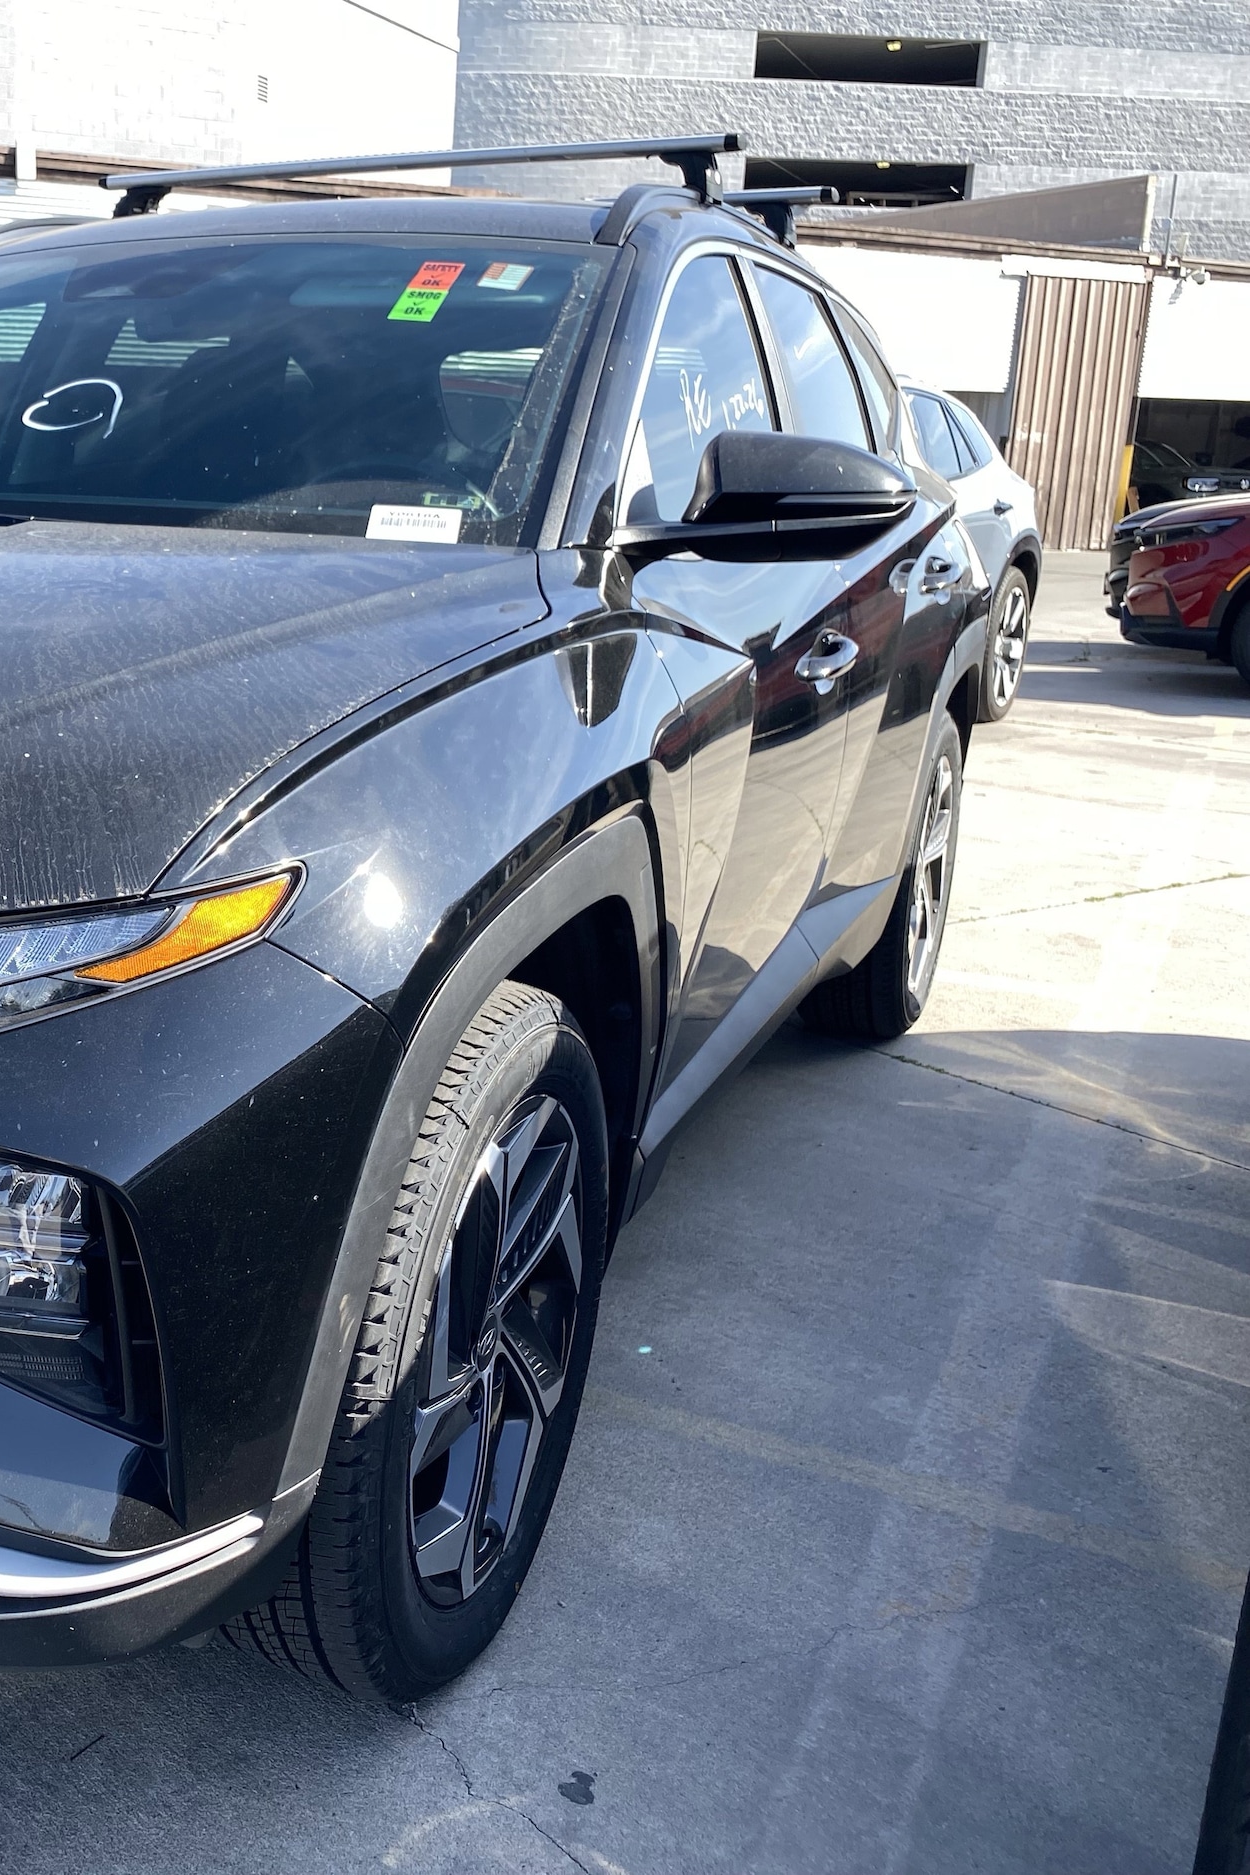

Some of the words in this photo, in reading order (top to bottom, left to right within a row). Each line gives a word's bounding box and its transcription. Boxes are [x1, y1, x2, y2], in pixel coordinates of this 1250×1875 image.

[424, 264, 460, 272] SAFETY
[407, 291, 442, 299] SMOG
[404, 307, 424, 315] OK
